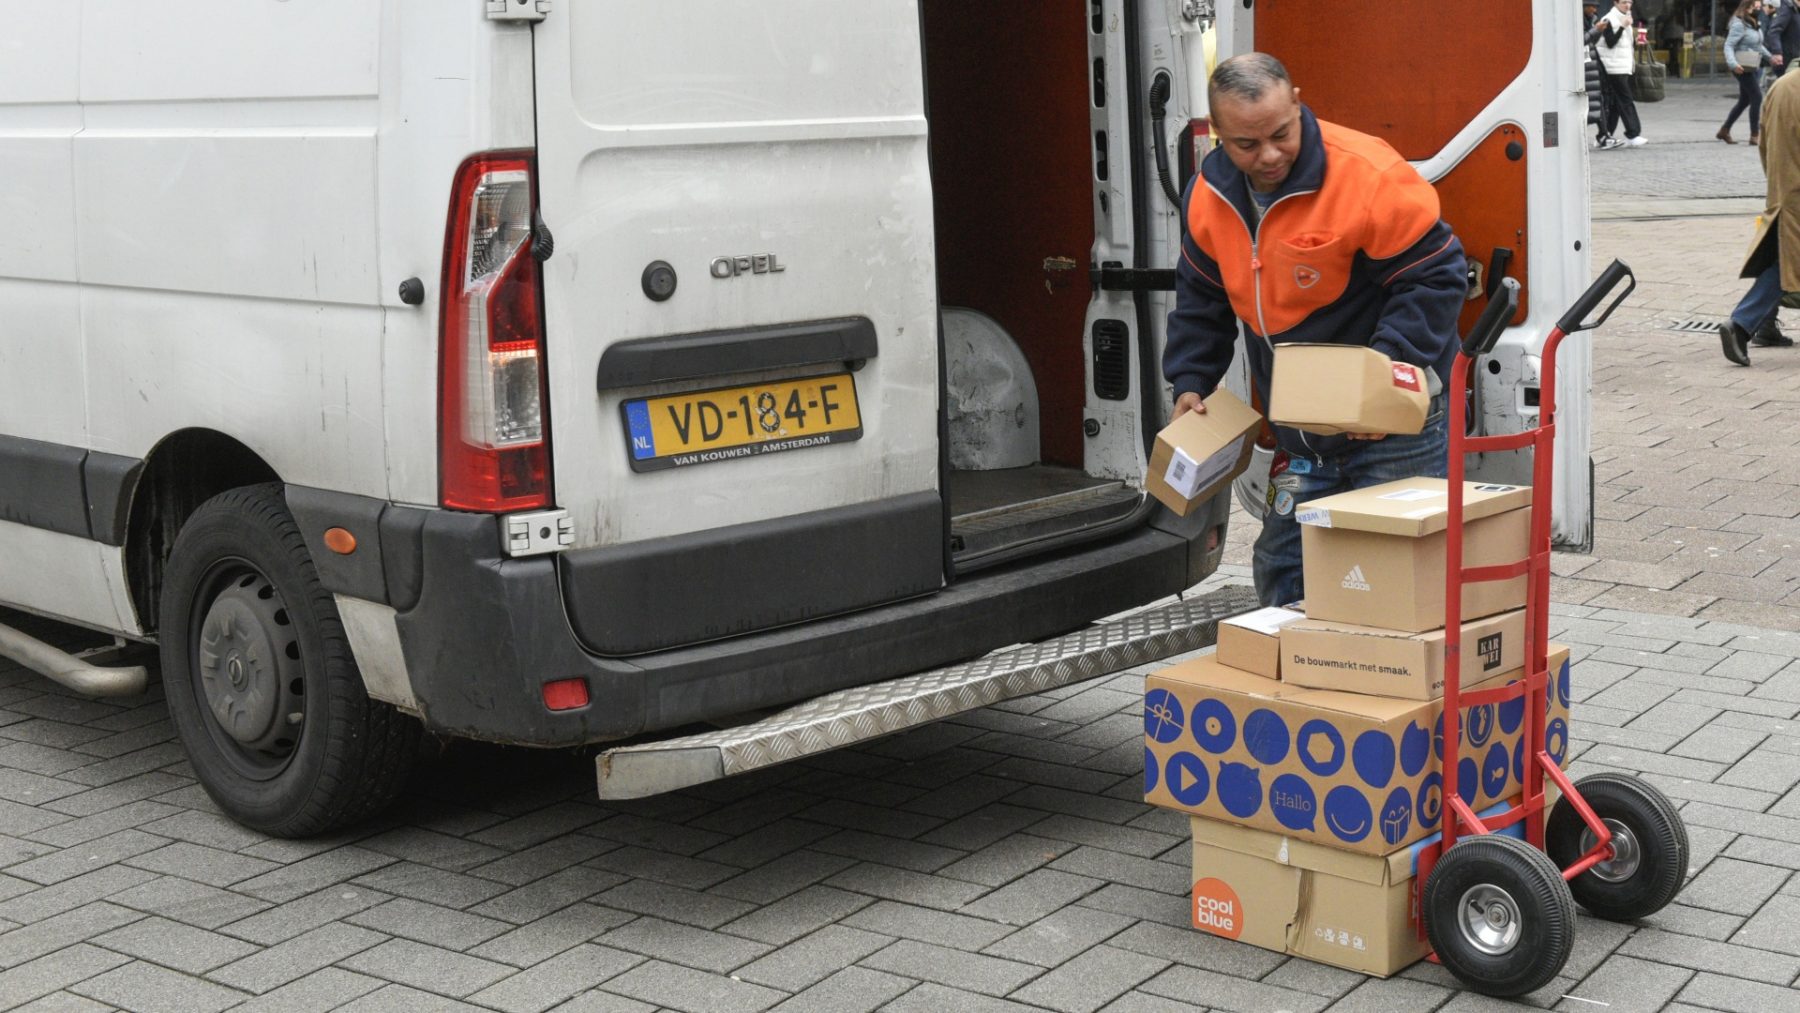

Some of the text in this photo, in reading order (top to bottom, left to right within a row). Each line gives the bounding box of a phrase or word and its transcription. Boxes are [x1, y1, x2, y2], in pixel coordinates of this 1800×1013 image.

[709, 253, 785, 279] OPEL
[667, 384, 840, 445] VD-184-F
[634, 437, 650, 449] NL
[674, 436, 830, 466] VAN KOUWEN AMSTERDAM
[1341, 580, 1370, 592] adidas
[1480, 638, 1499, 654] KAR
[1294, 655, 1412, 676] De bouwmarkt met smaak.
[1484, 649, 1499, 665] WEI
[1275, 791, 1312, 812] Hallo
[1198, 896, 1234, 916] cool
[1198, 908, 1234, 931] blue
